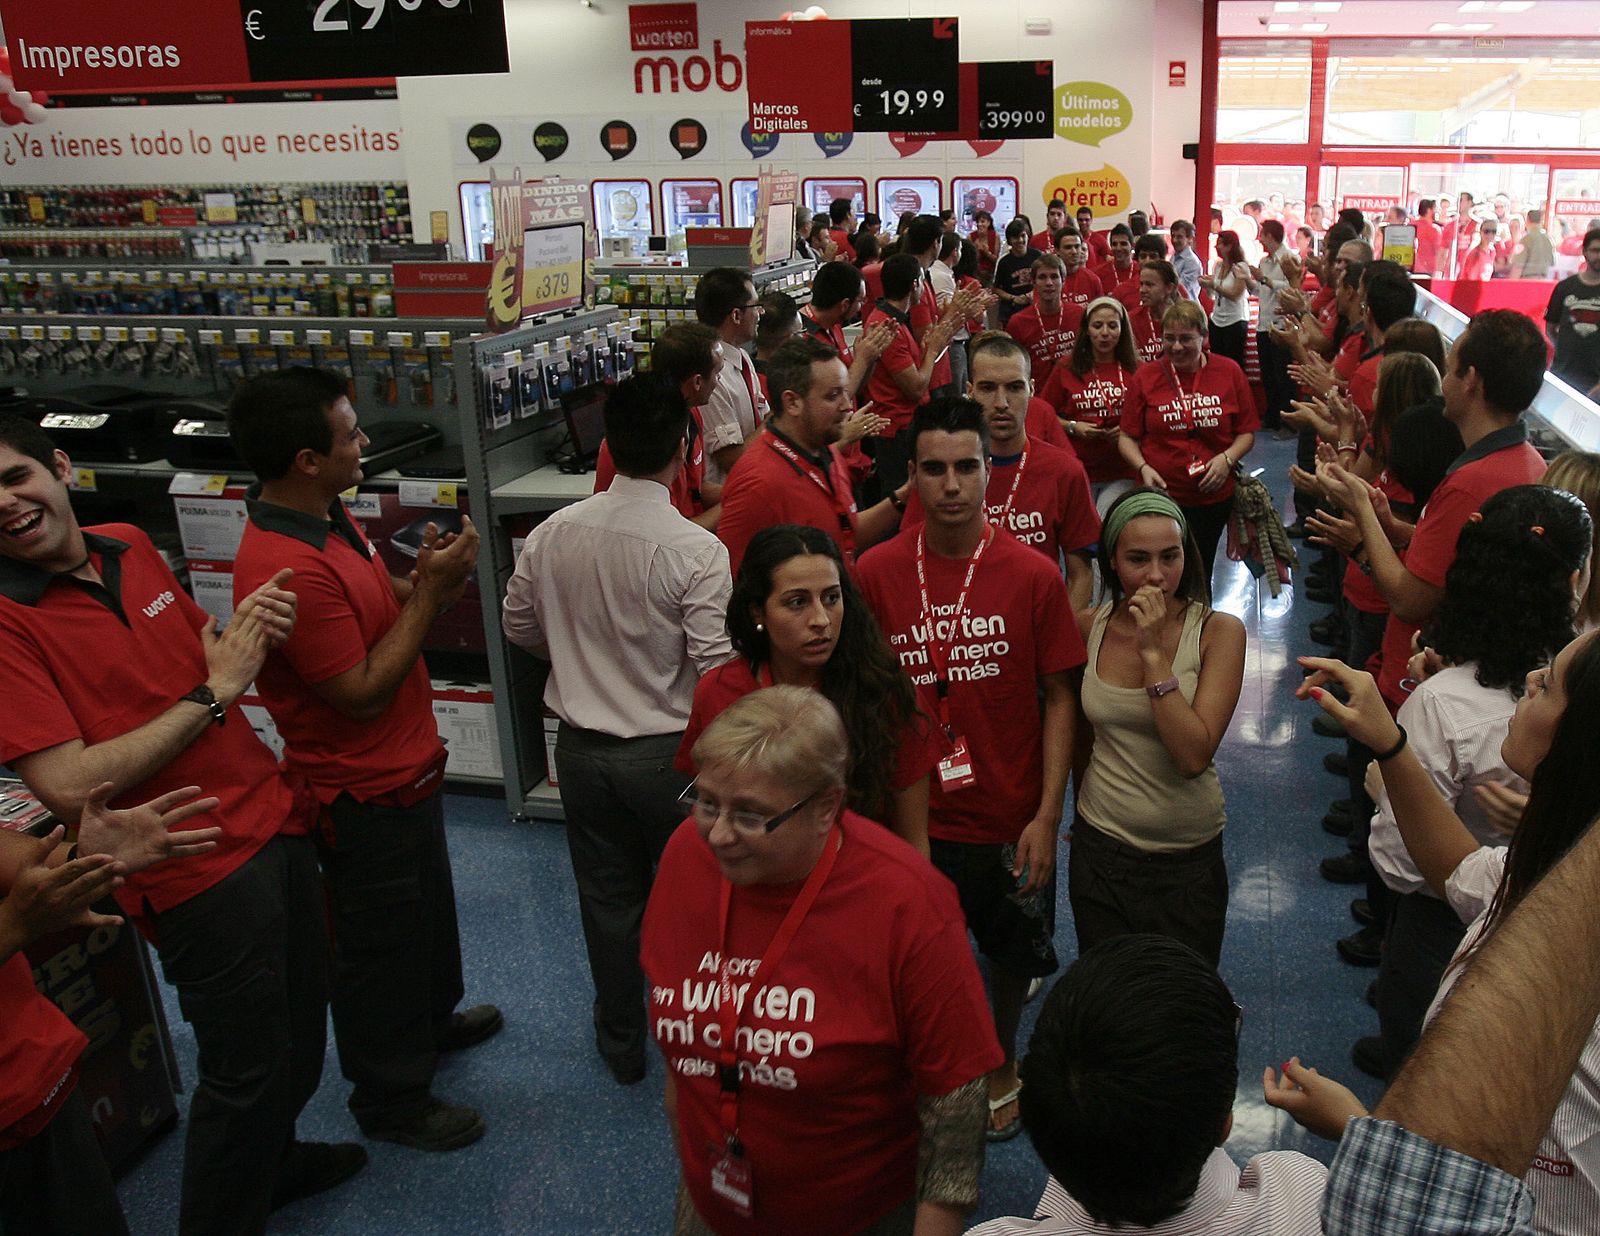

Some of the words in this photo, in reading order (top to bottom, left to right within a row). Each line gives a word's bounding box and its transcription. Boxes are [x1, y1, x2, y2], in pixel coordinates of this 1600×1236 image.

[246, 9, 266, 40] €
[749, 27, 793, 36] informática
[635, 30, 694, 47] worten
[19, 38, 181, 77] Impresoras
[861, 78, 883, 86] desde
[752, 102, 799, 115] Marcos
[879, 89, 945, 116] 19,99
[1061, 91, 1121, 110] Últimos
[753, 117, 809, 132] Digitales
[1059, 113, 1123, 128] modelos
[4, 132, 44, 165] ¿Ya
[51, 131, 123, 157] tienes
[131, 129, 184, 156] todo
[188, 129, 211, 155] lo
[222, 134, 267, 162] que
[522, 184, 588, 198] DINERO
[1076, 177, 1086, 188] la
[1089, 178, 1121, 191] mejor
[533, 195, 578, 209] VALE
[1052, 187, 1119, 207] Oferta
[1346, 198, 1396, 210] ENTRADA
[530, 204, 585, 224] MÁS
[142, 591, 175, 618] worte
[890, 633, 908, 645] en
[899, 645, 928, 666] mi
[947, 660, 1001, 682] más
[1535, 1158, 1569, 1175] orten
